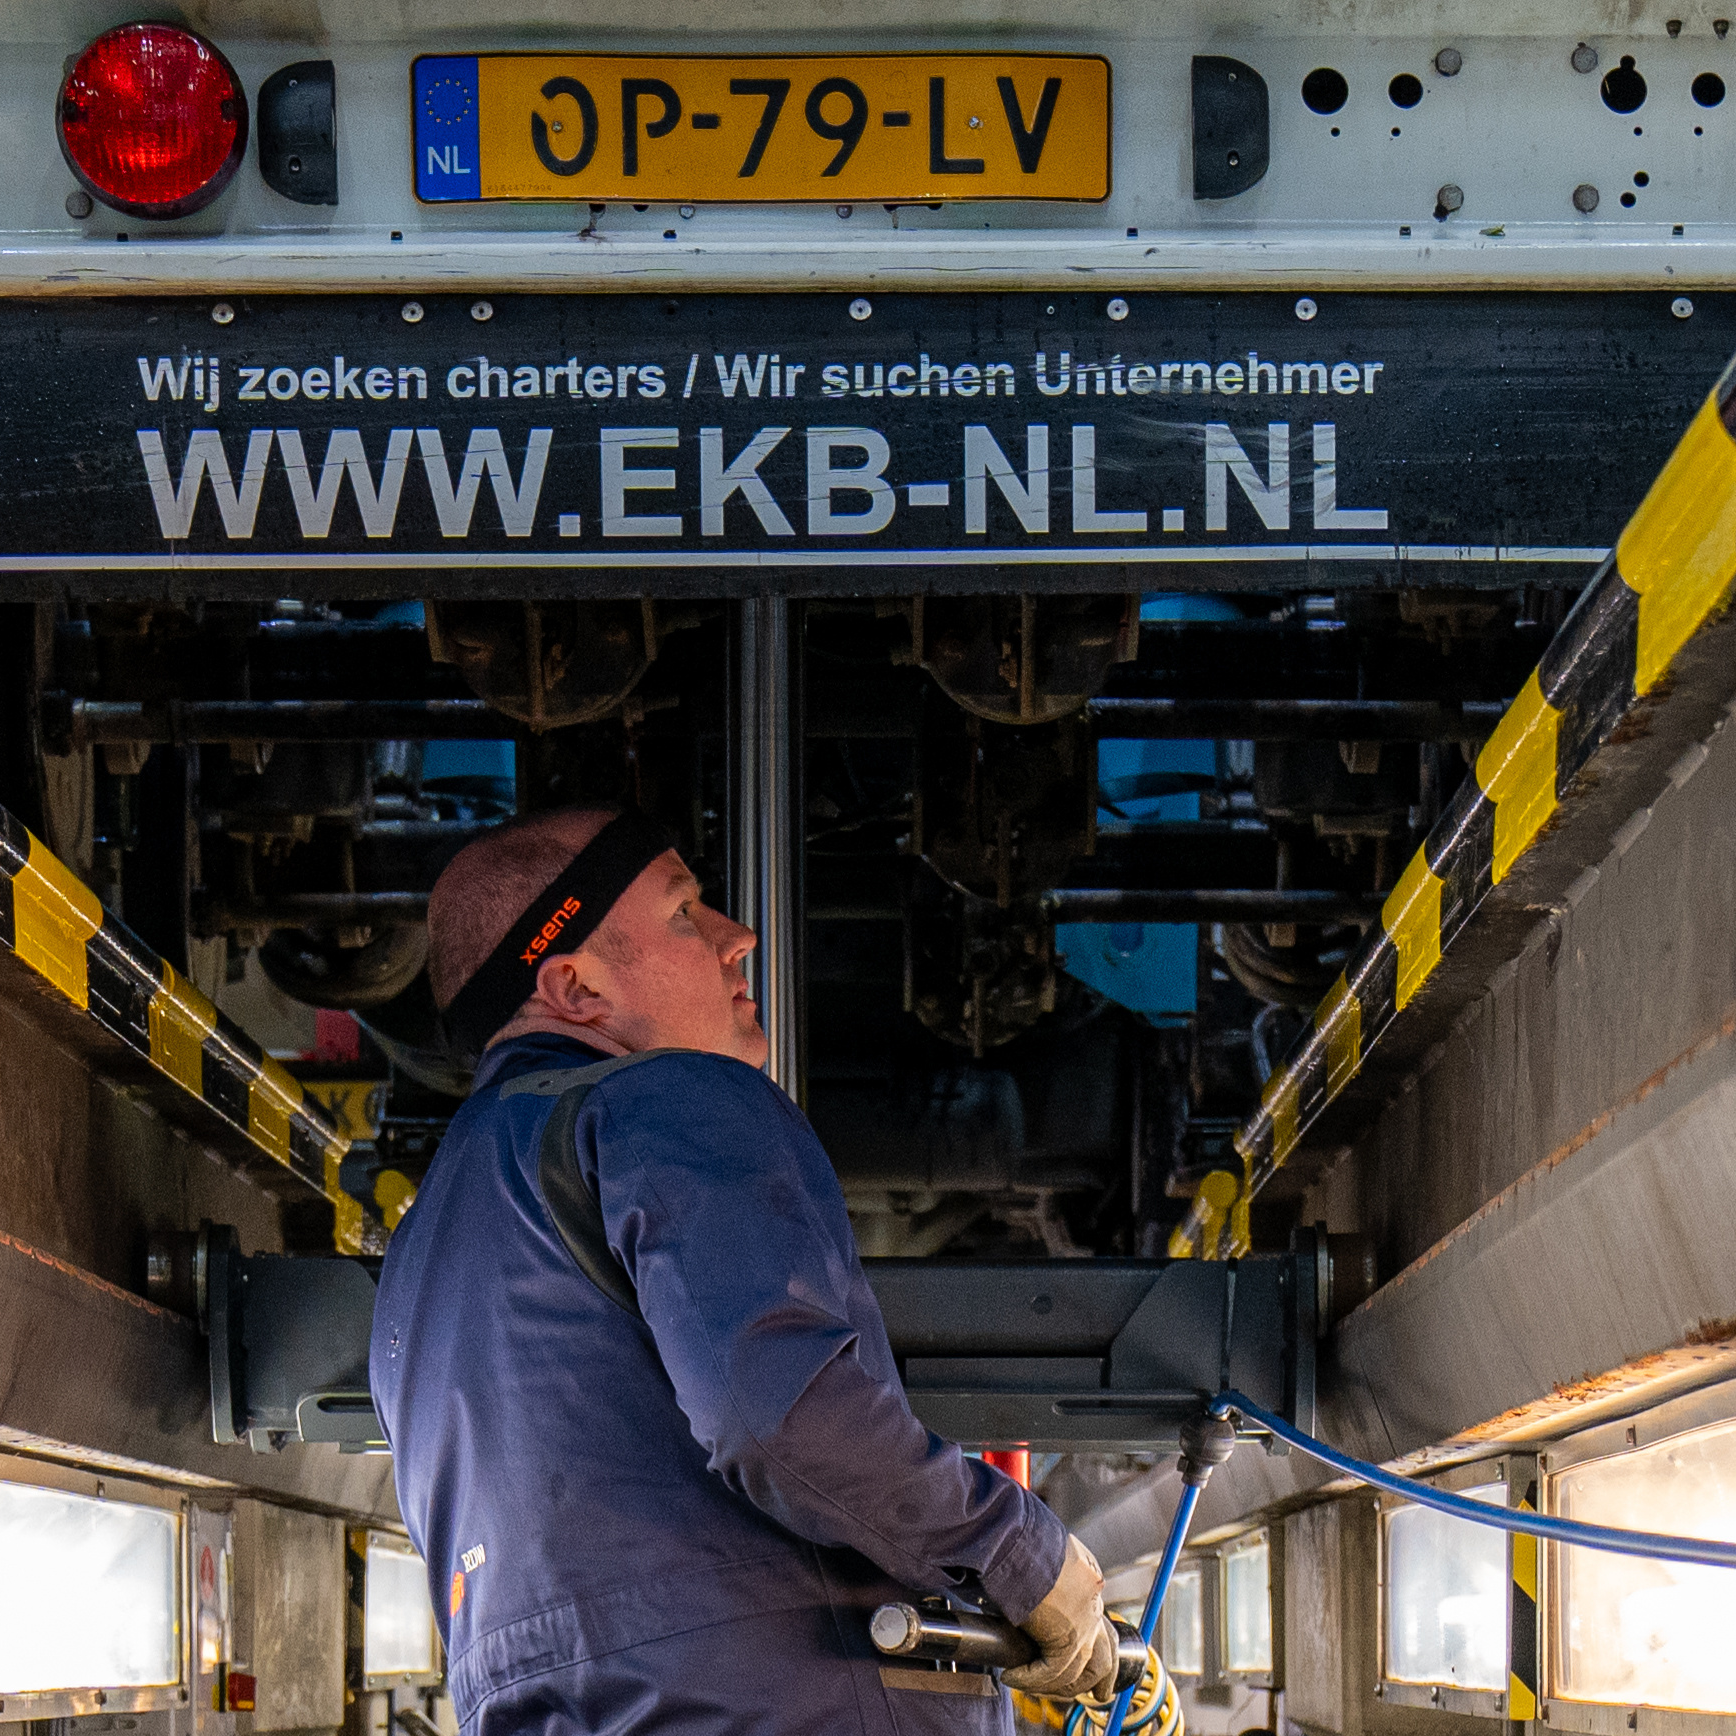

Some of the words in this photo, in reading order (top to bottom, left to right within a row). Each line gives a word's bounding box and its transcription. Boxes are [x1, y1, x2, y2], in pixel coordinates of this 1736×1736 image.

[530, 75, 1064, 179] OP-79-LV
[426, 145, 471, 175] NL
[137, 356, 220, 412] Wij
[237, 355, 428, 400] zoeken
[446, 355, 667, 399] charters
[682, 353, 700, 398] /
[714, 353, 806, 398] Wir
[820, 353, 1016, 398] suchen
[1035, 351, 1385, 396] Unternehmer
[135, 422, 1389, 540] WWW.EKB-NL.NL
[520, 896, 582, 966] xsens
[460, 1543, 486, 1574] RDW
